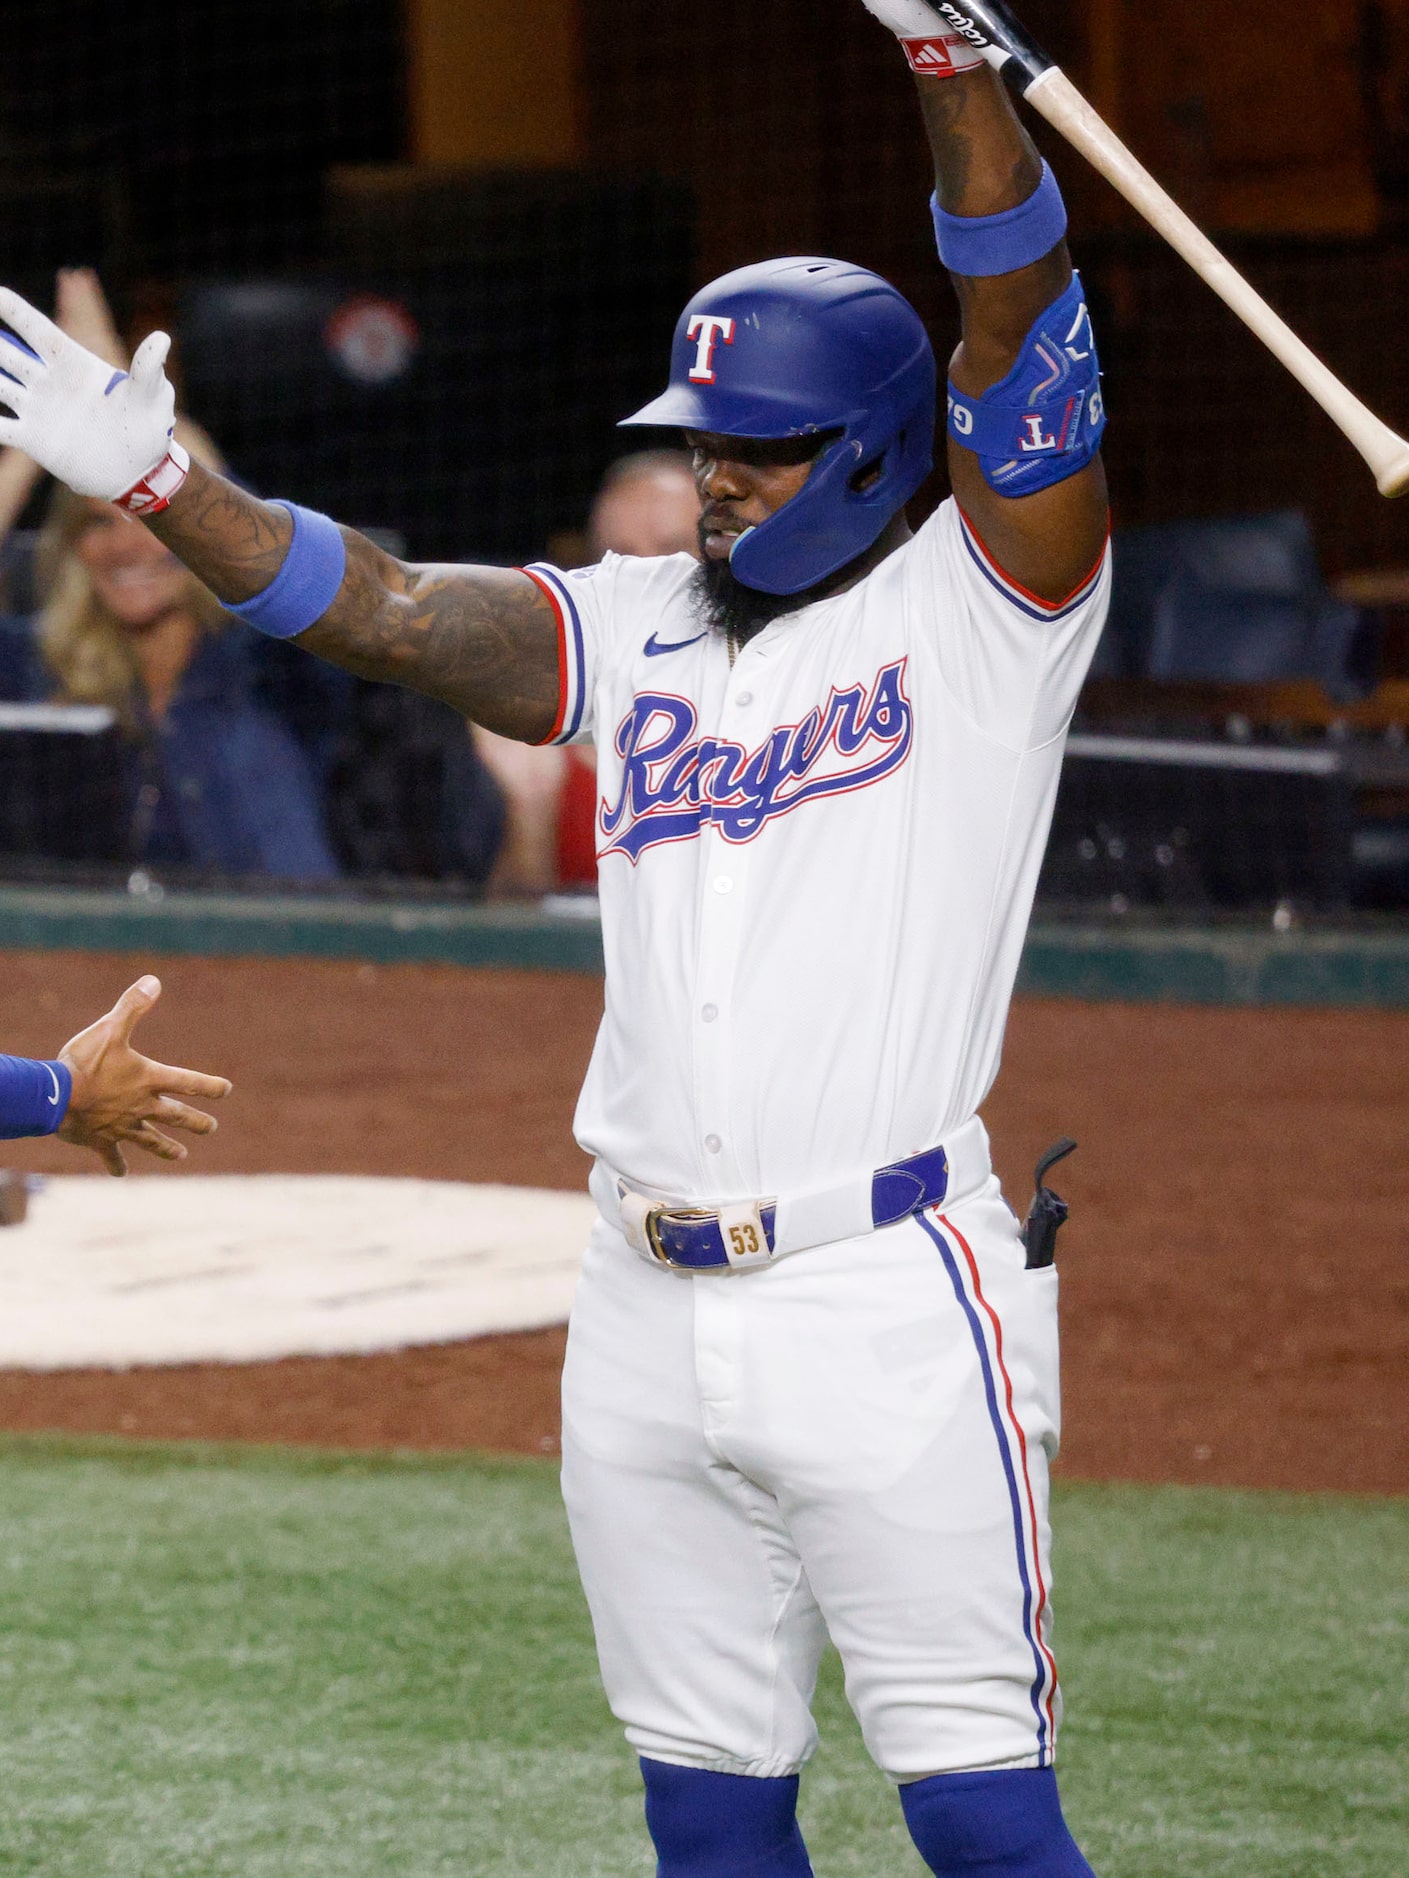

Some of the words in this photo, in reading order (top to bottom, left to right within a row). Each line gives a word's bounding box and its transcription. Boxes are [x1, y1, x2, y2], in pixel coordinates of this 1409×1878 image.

[686, 314, 736, 385] T
[1018, 413, 1056, 452] T
[596, 654, 914, 868] Rangers
[728, 1223, 760, 1256] 53
